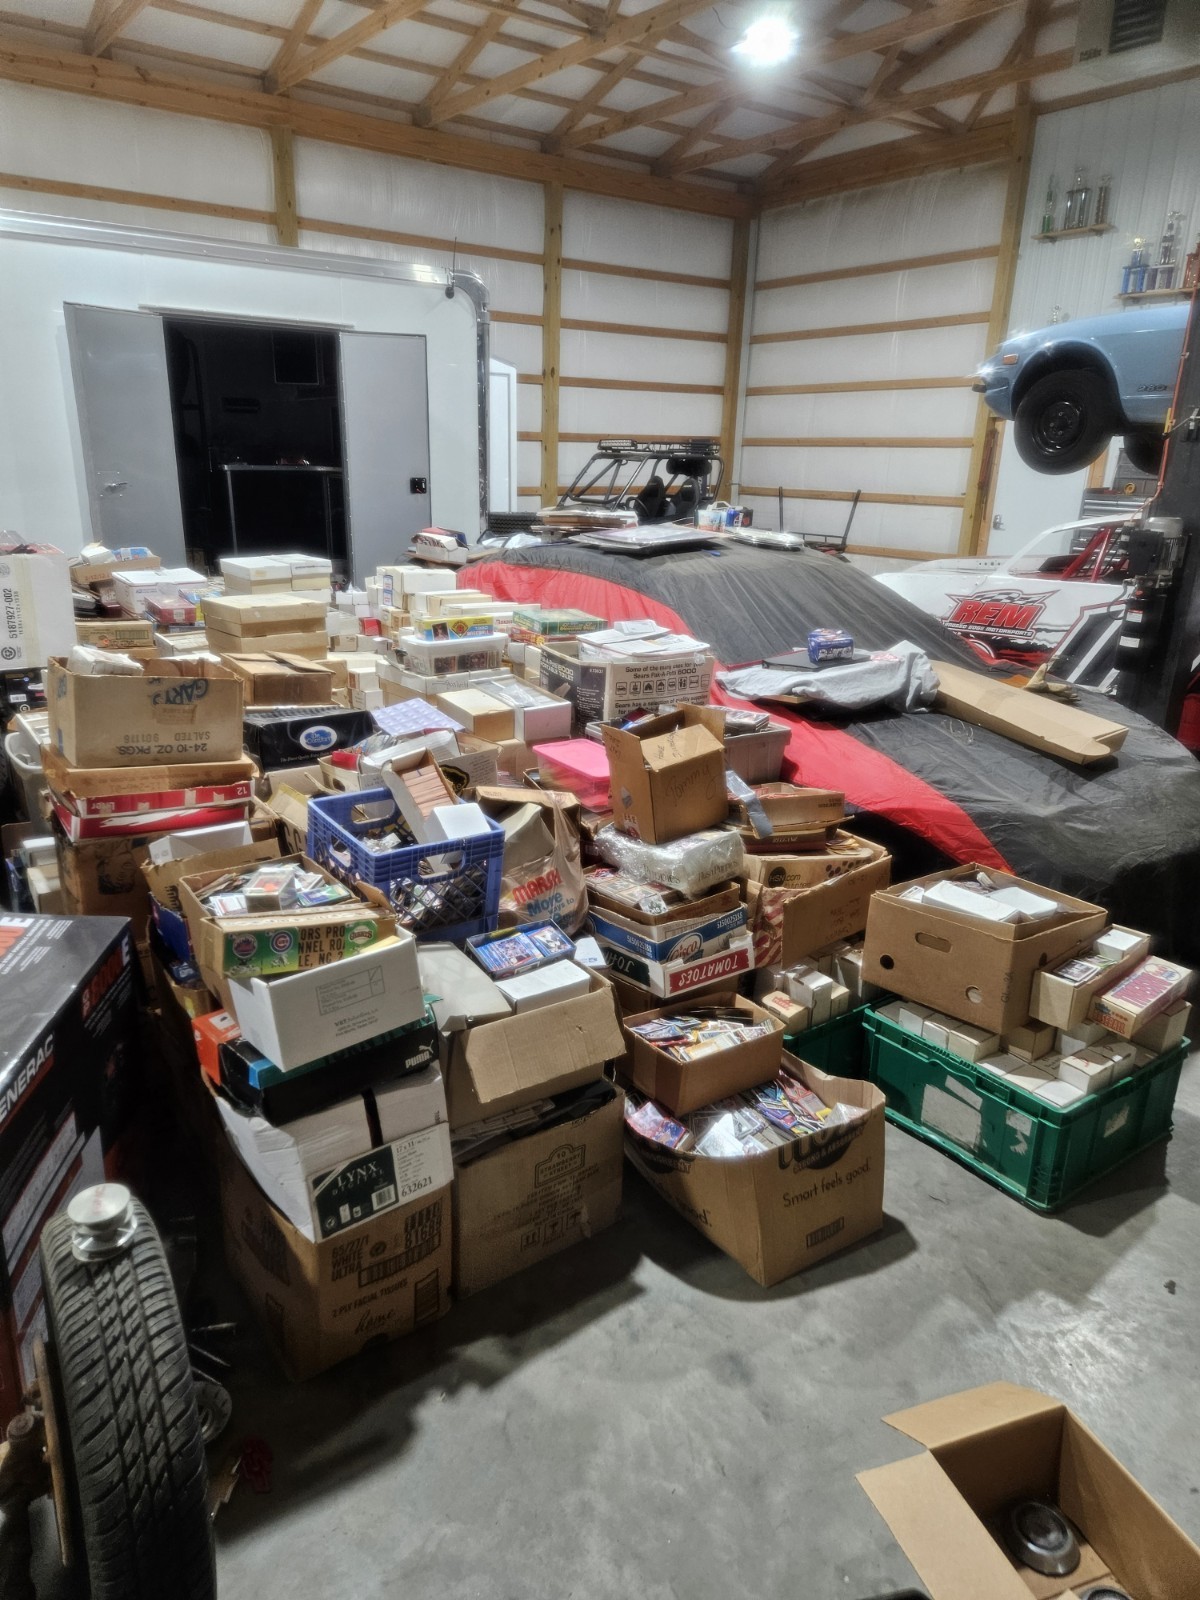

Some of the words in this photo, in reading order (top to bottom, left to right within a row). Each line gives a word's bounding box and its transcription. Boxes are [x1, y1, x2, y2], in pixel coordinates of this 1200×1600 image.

[2, 588, 18, 639] 5187927-002
[953, 601, 1040, 630] REM
[985, 625, 1033, 636] MOTORSPORTS
[677, 668, 697, 676] 6000
[648, 699, 669, 707] selection
[174, 731, 211, 742] SALTED
[177, 743, 208, 753] 24-10
[236, 786, 248, 796] 12
[769, 874, 801, 883] HSN.com
[527, 892, 563, 917] More
[298, 928, 321, 943] ORS
[678, 957, 740, 988] TOMATOES
[405, 1051, 431, 1069] PUMA
[0, 1033, 54, 1119] ENERAC
[331, 1169, 386, 1197] DIGITAL
[336, 1161, 378, 1188] LYNX
[401, 1176, 433, 1198] 632621
[782, 1182, 818, 1210] Smart
[821, 1173, 844, 1196] feels
[331, 1248, 364, 1269] WHITE
[379, 1278, 408, 1298] TISSUES
